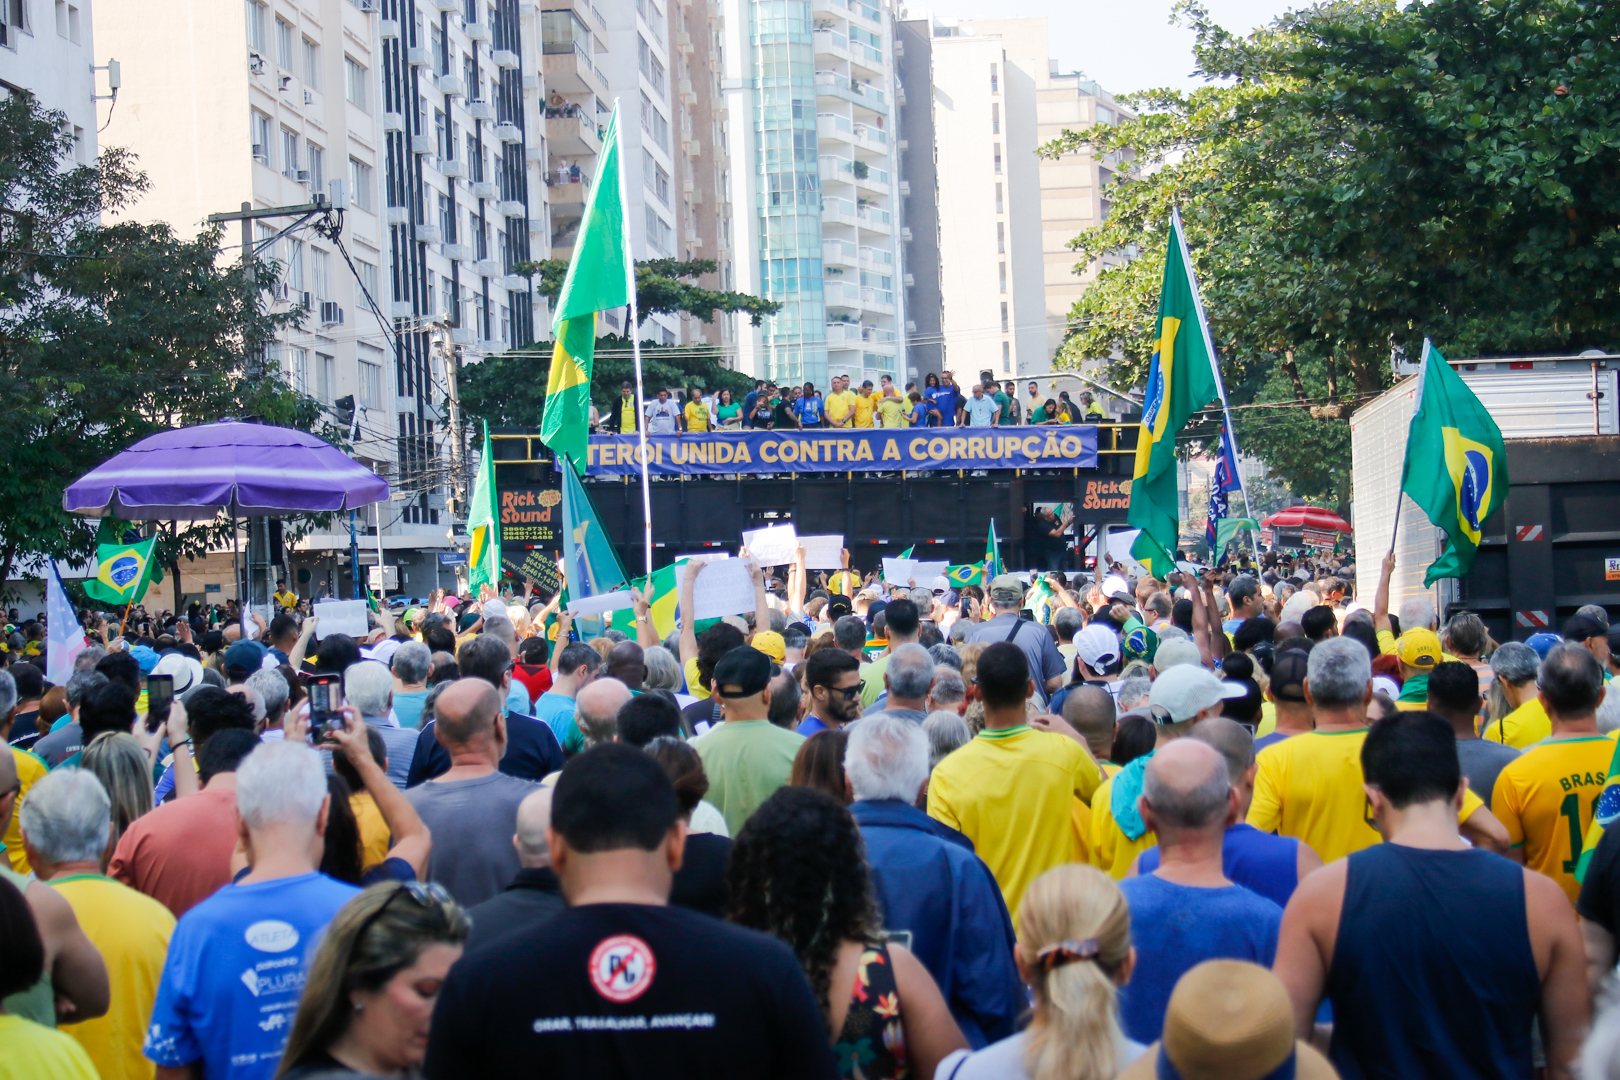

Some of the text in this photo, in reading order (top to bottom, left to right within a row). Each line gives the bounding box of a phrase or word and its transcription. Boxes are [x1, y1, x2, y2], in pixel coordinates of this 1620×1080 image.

[588, 431, 1083, 466] TEROI UNIDA CONTRA A CORRUPÇÃO
[1085, 481, 1119, 499] Rick
[502, 491, 536, 512] Rick
[1082, 494, 1131, 510] Sound
[501, 507, 551, 524] Sound
[530, 550, 557, 570] 3860-57
[521, 563, 559, 589] 96461-1410
[1559, 772, 1606, 792] BRAS
[258, 972, 306, 991] PLURA
